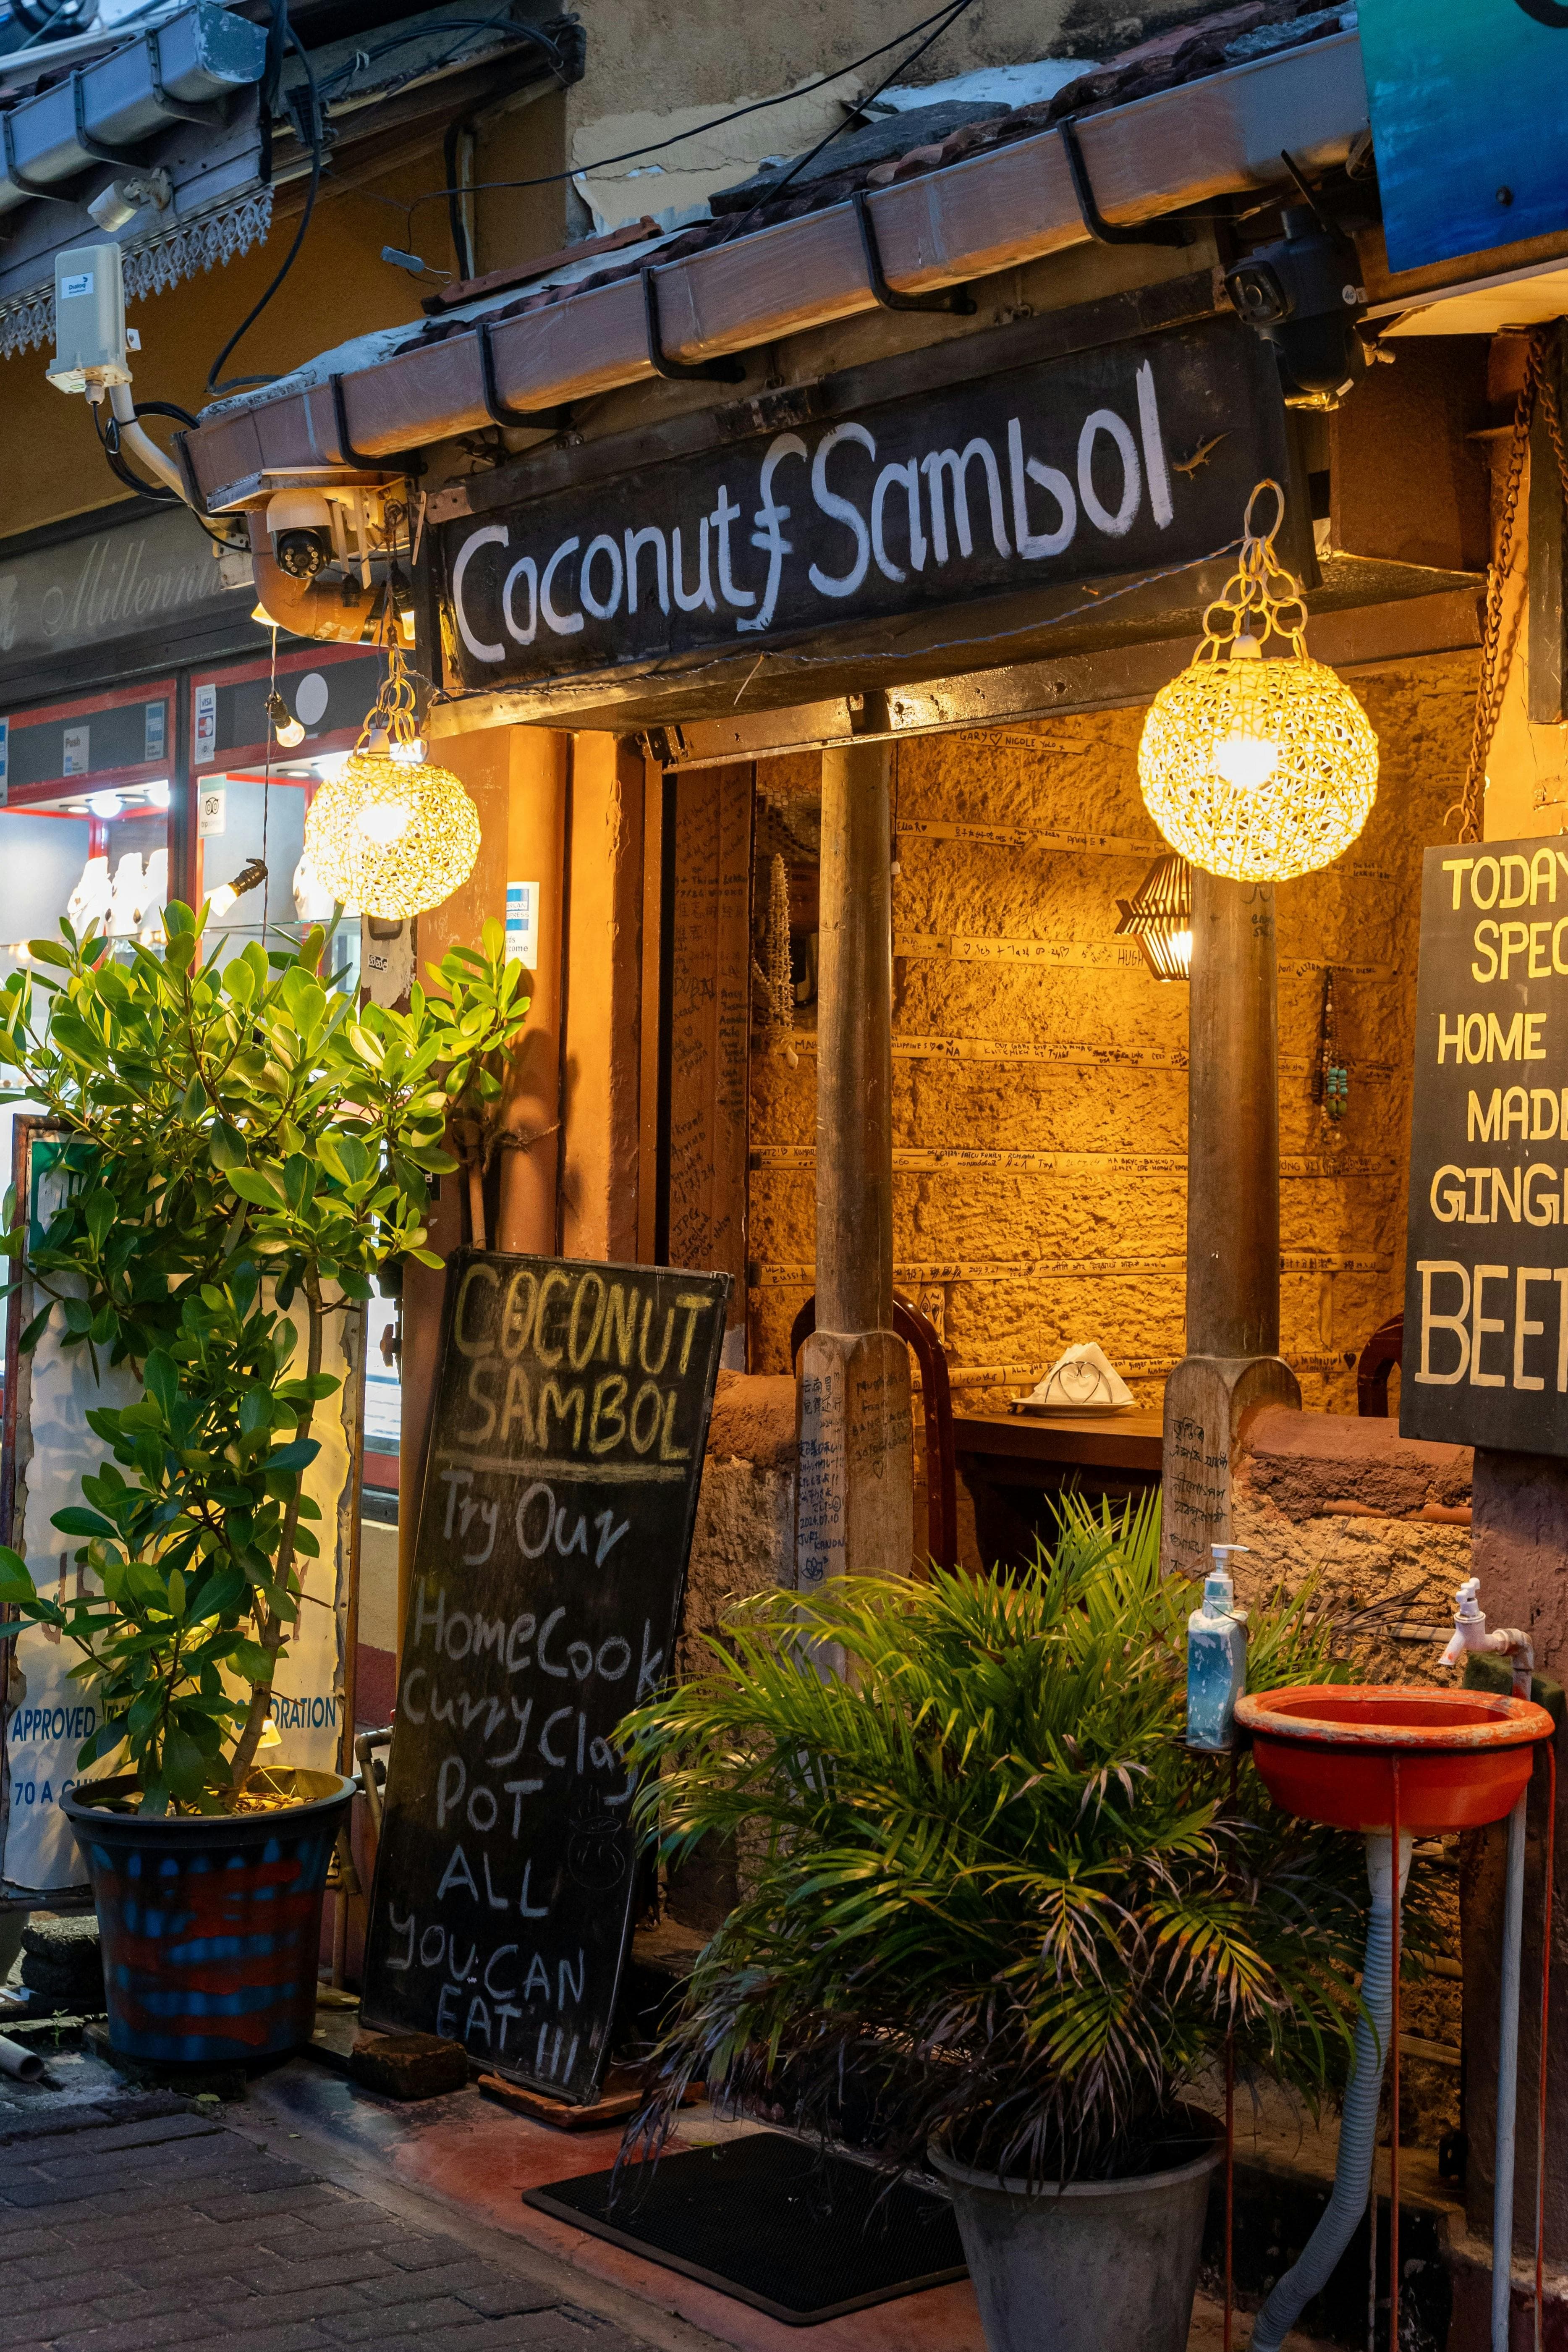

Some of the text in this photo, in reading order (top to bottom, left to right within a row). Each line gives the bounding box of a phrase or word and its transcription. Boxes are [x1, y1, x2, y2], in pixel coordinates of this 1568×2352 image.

[453, 484, 757, 663] Coconut
[808, 360, 1175, 599] Sambol
[202, 697, 212, 707] VISA
[960, 731, 987, 743] GARY
[1005, 738, 1036, 747] NICOLE
[1130, 843, 1166, 853] Yummy Food
[1437, 1013, 1546, 1064] HOME
[794, 1147, 817, 1157] KUMAR
[454, 1263, 714, 1376] COCONUT
[1129, 1361, 1147, 1371] ginger
[457, 1358, 693, 1461] SAMBOL
[440, 1469, 500, 1566] Try
[11, 1705, 96, 1743] APPROVED
[15, 1782, 35, 1805] 70
[41, 1780, 54, 1803] A
[437, 1755, 544, 1839] POT
[437, 1844, 551, 1918] ALL
[484, 1944, 584, 2011] CAN
[437, 1984, 523, 2050] EAT
